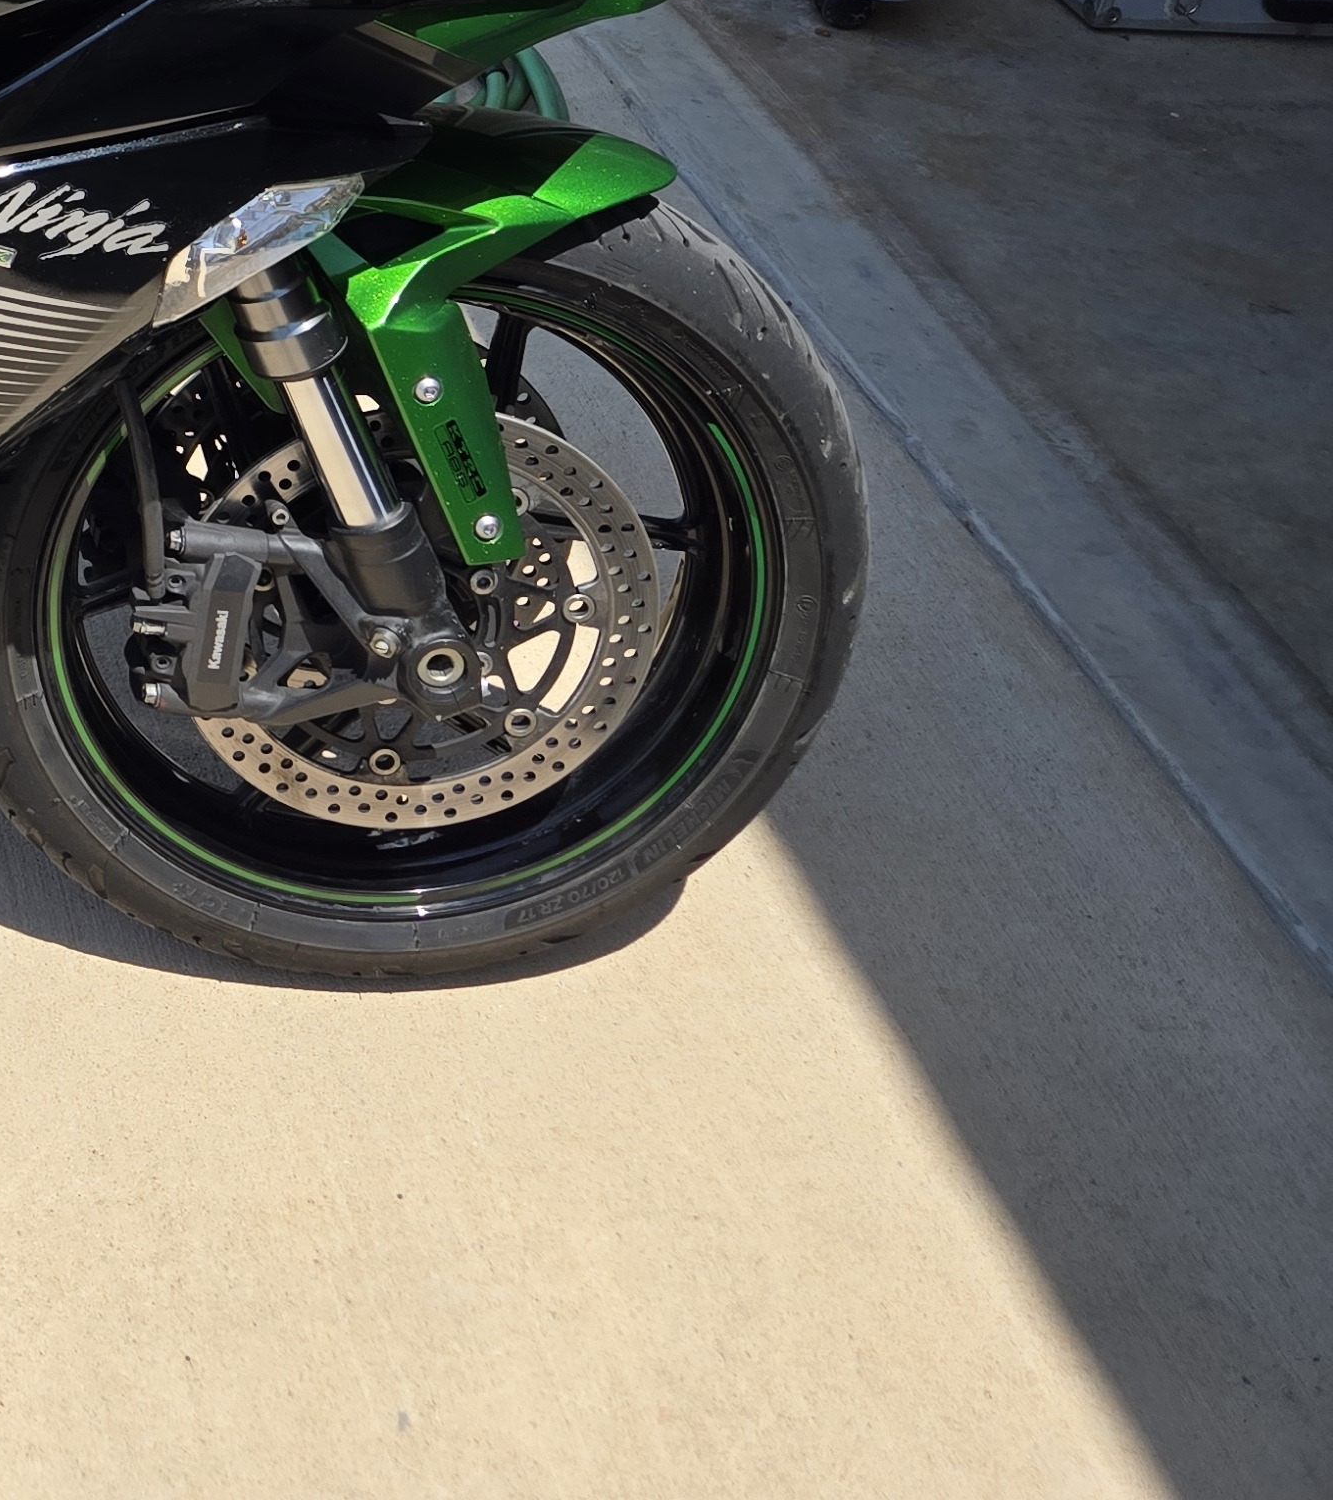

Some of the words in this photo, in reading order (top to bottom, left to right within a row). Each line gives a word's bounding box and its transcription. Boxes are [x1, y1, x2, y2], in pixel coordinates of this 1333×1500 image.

[207, 609, 230, 670] Kawasaki
[641, 777, 733, 864] MICHELIN
[567, 867, 627, 904] 120/70
